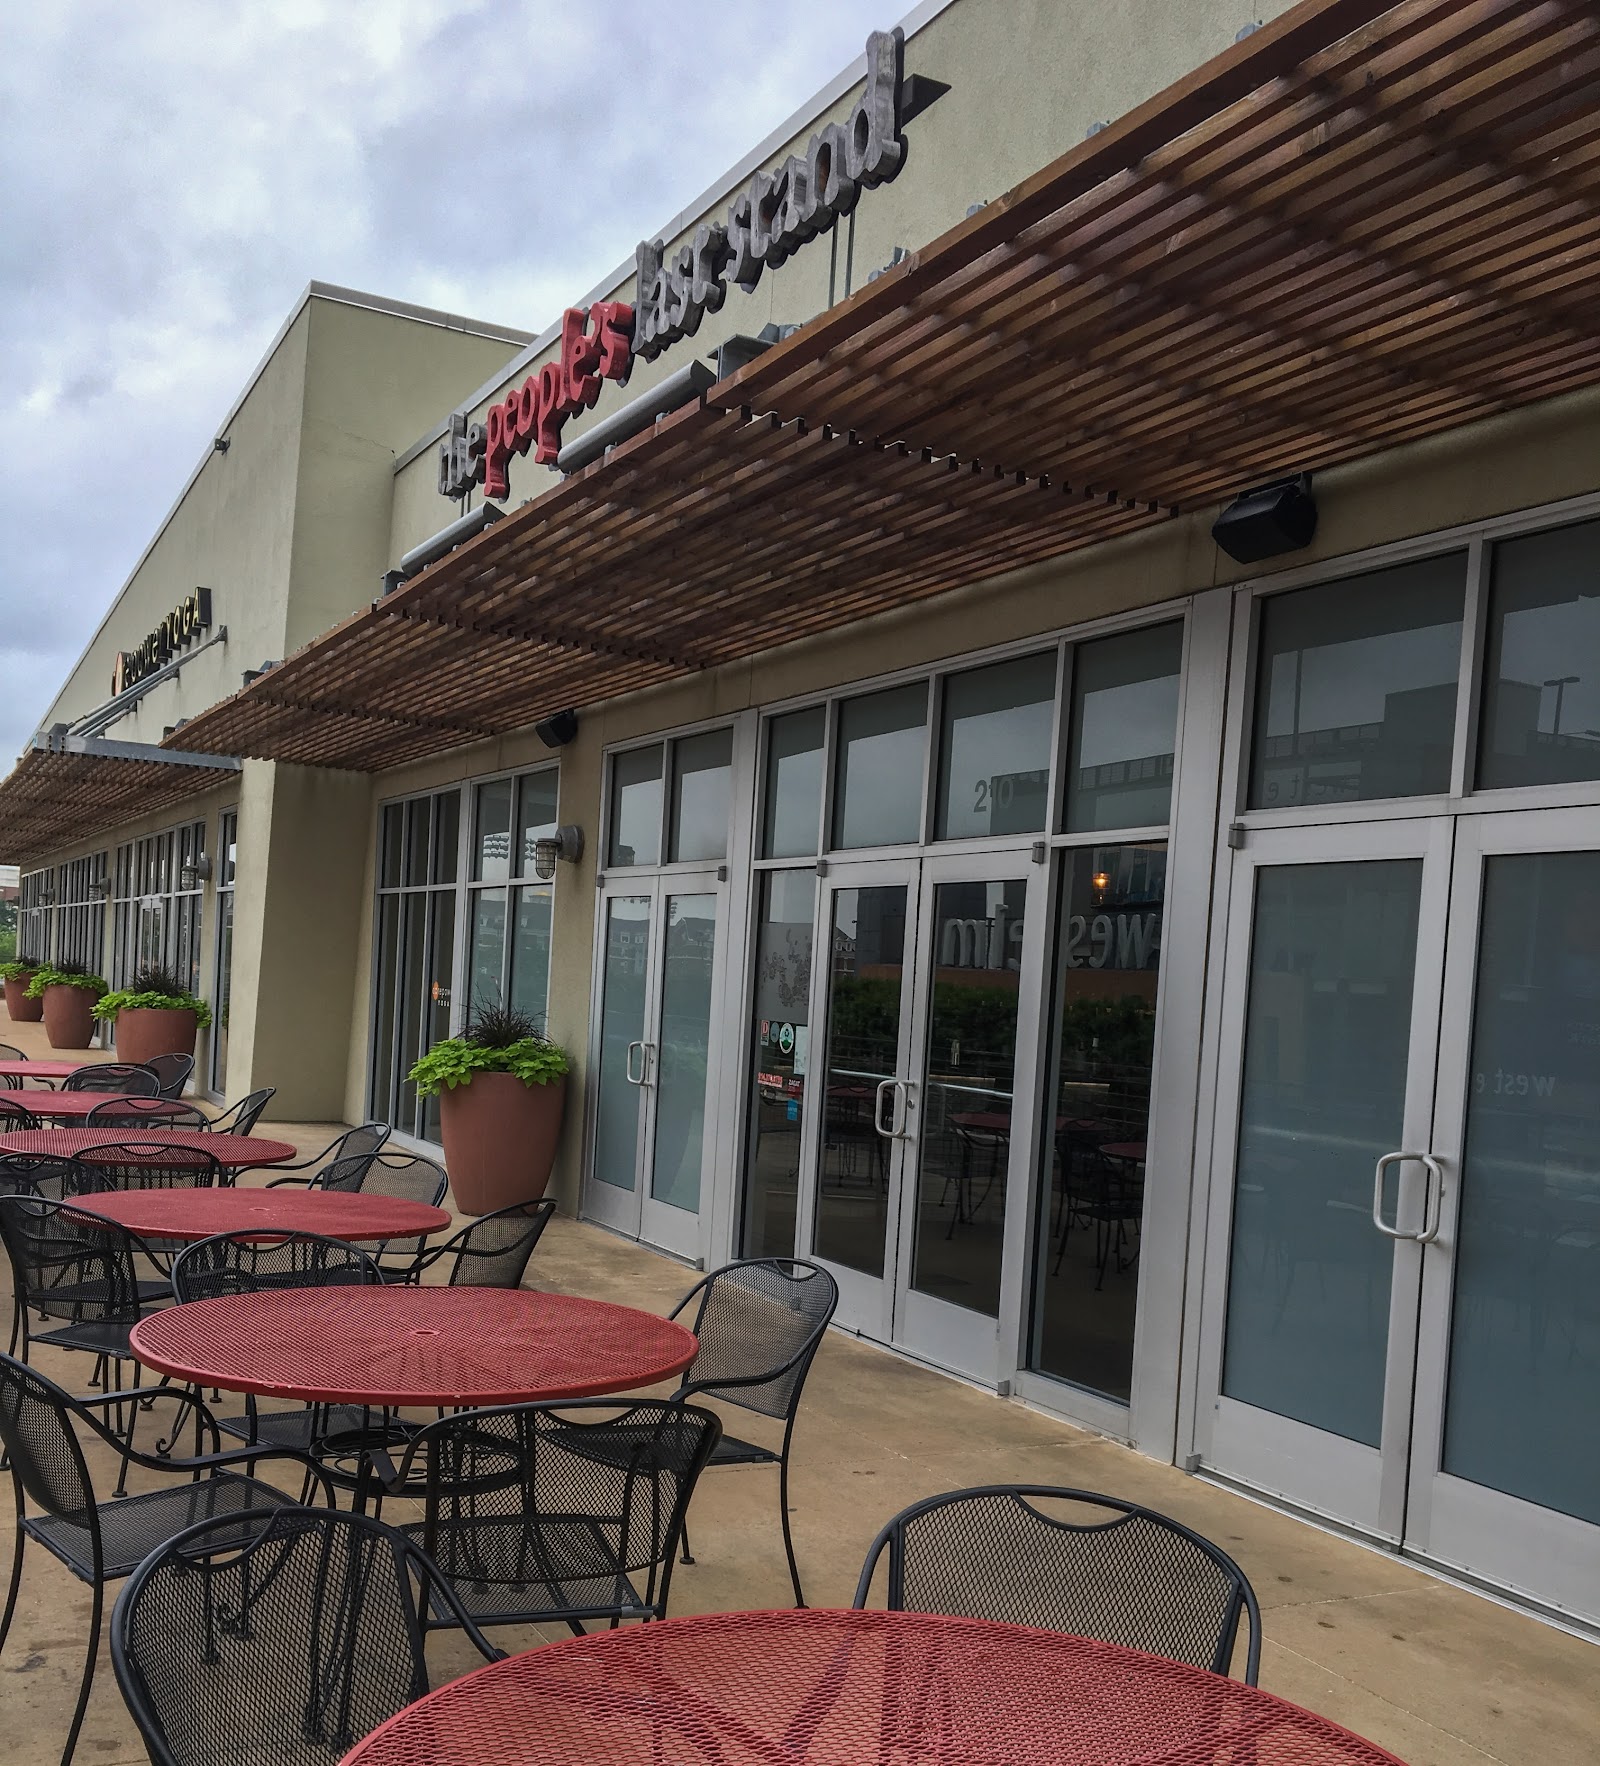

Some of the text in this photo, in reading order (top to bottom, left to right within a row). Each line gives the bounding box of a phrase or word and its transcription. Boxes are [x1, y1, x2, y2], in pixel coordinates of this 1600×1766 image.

[438, 412, 488, 499] the
[631, 223, 728, 361] last
[726, 27, 907, 292] stand
[165, 586, 212, 651] YOGA
[973, 778, 1014, 812] 210
